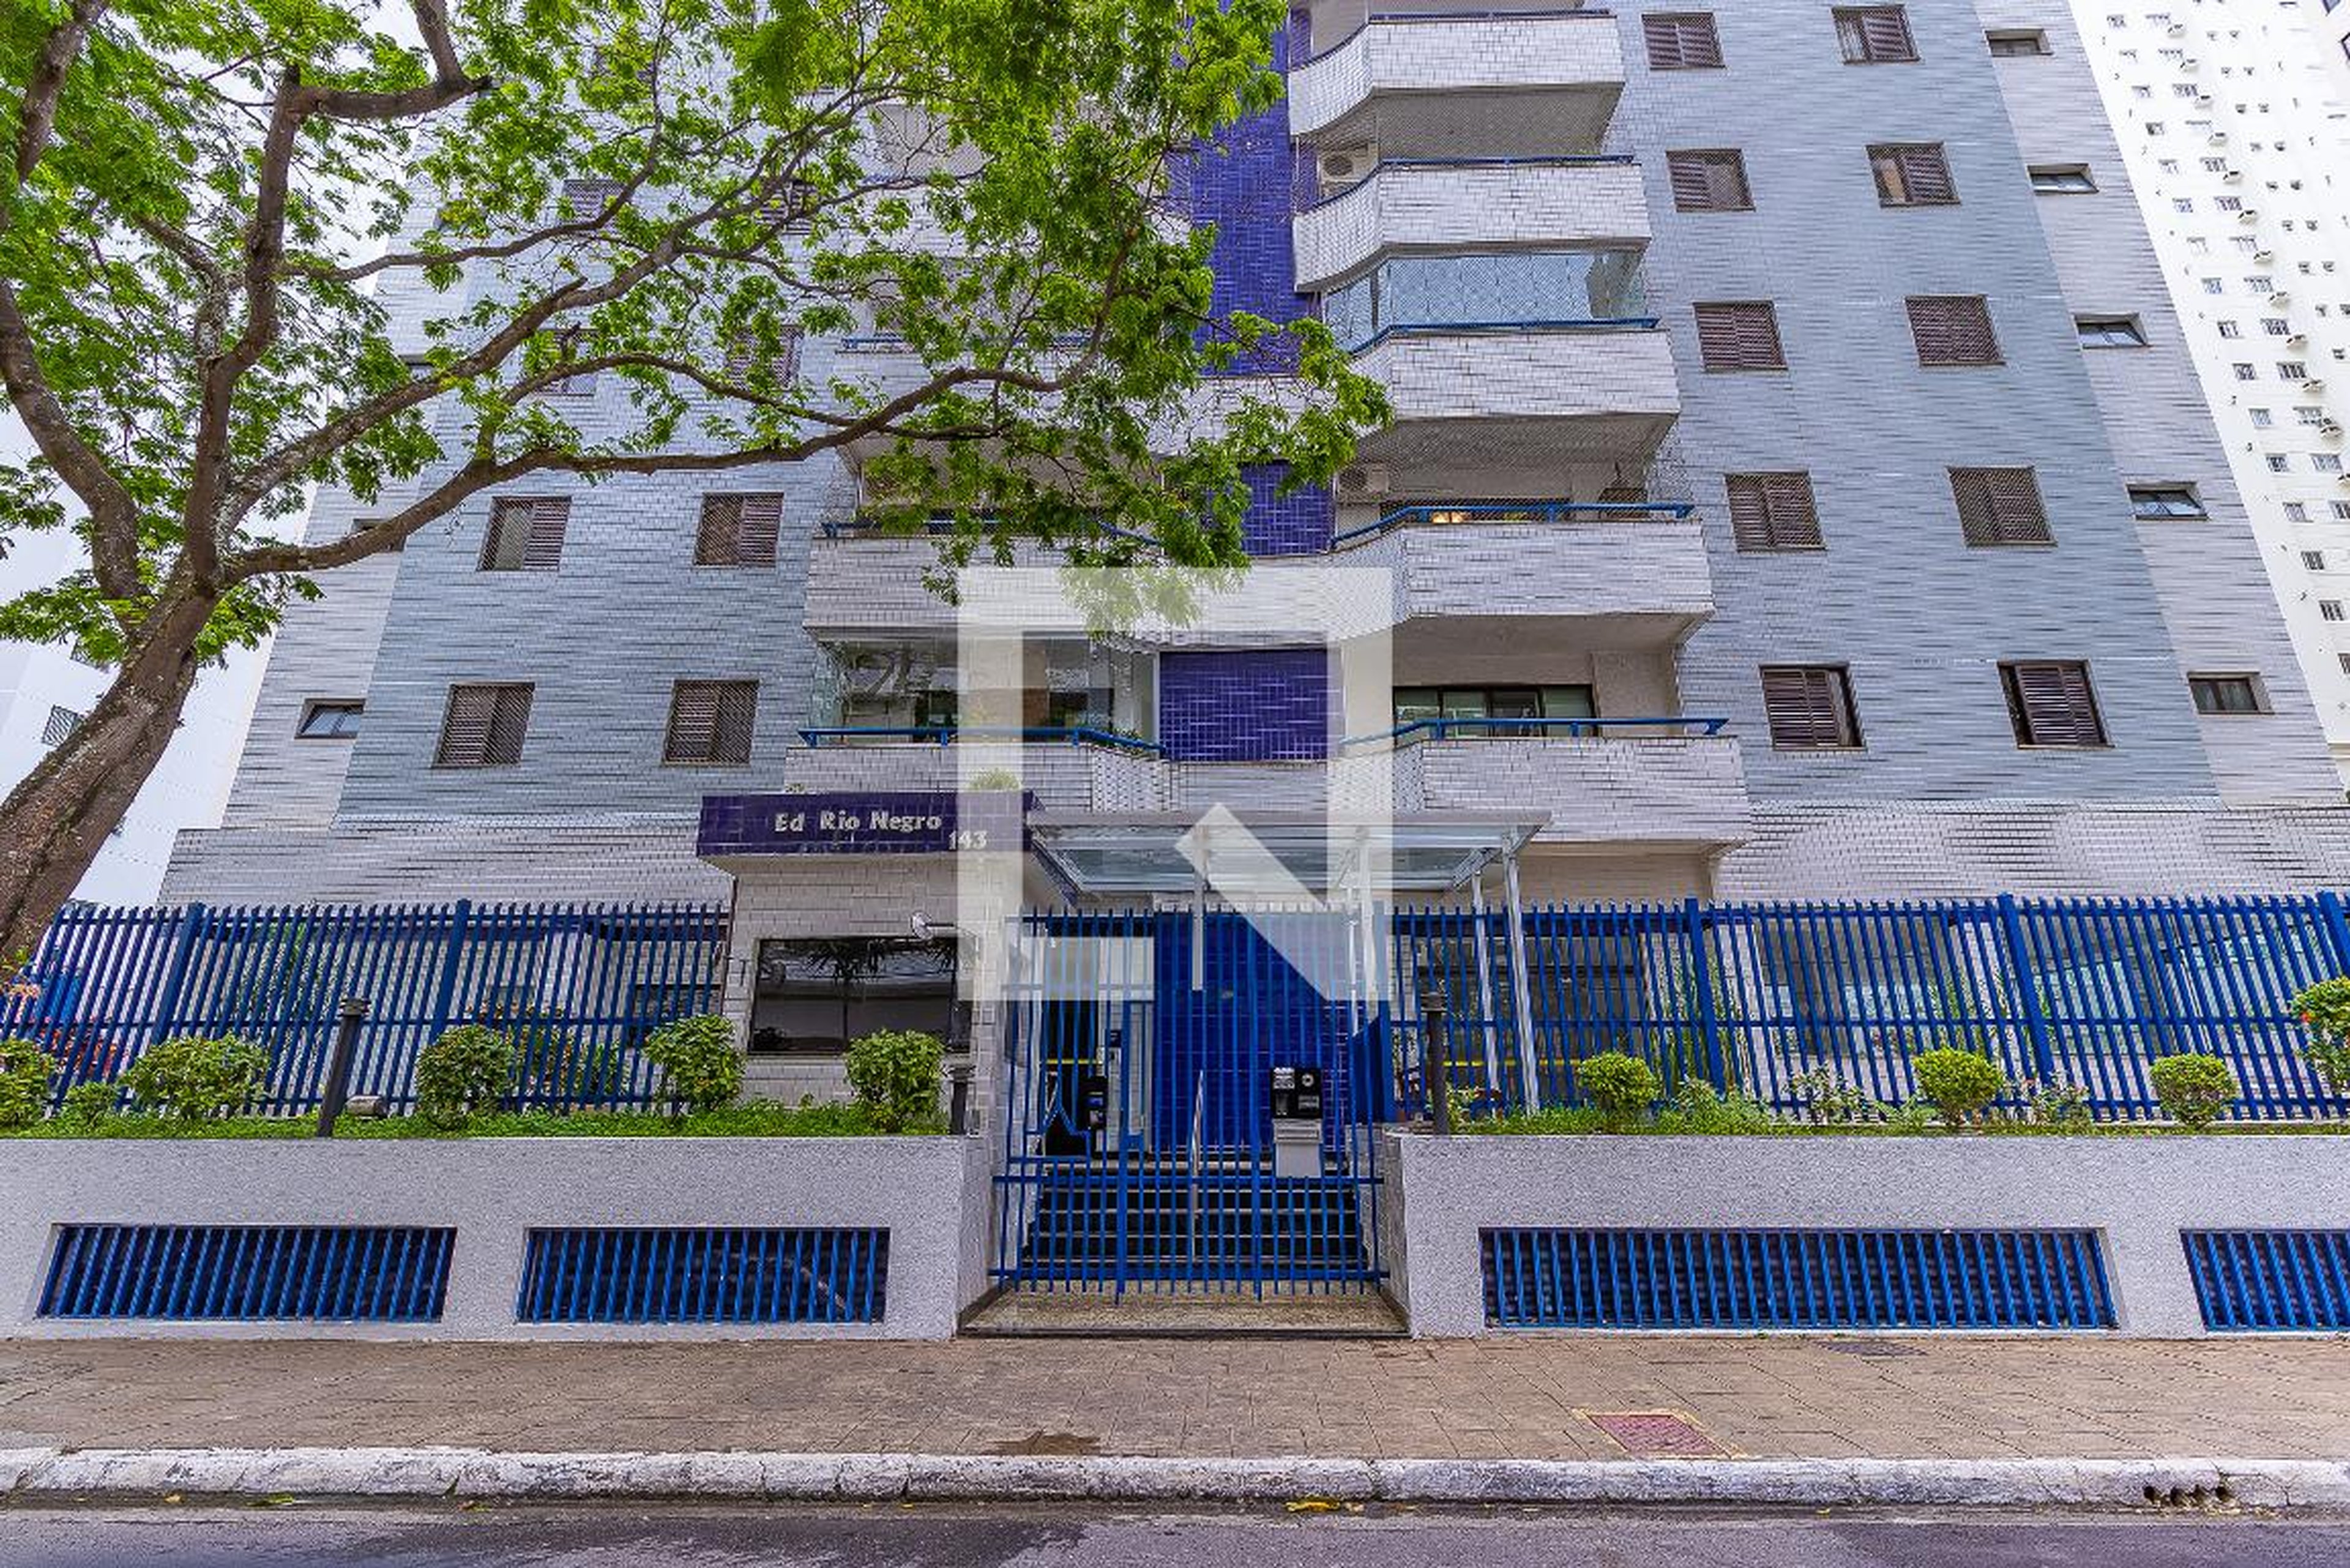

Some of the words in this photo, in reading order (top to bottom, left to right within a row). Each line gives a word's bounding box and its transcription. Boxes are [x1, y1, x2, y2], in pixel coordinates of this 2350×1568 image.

[775, 811, 805, 832] Ed
[820, 810, 860, 831] Rio
[869, 810, 942, 833] Negro
[949, 830, 988, 849] 143
